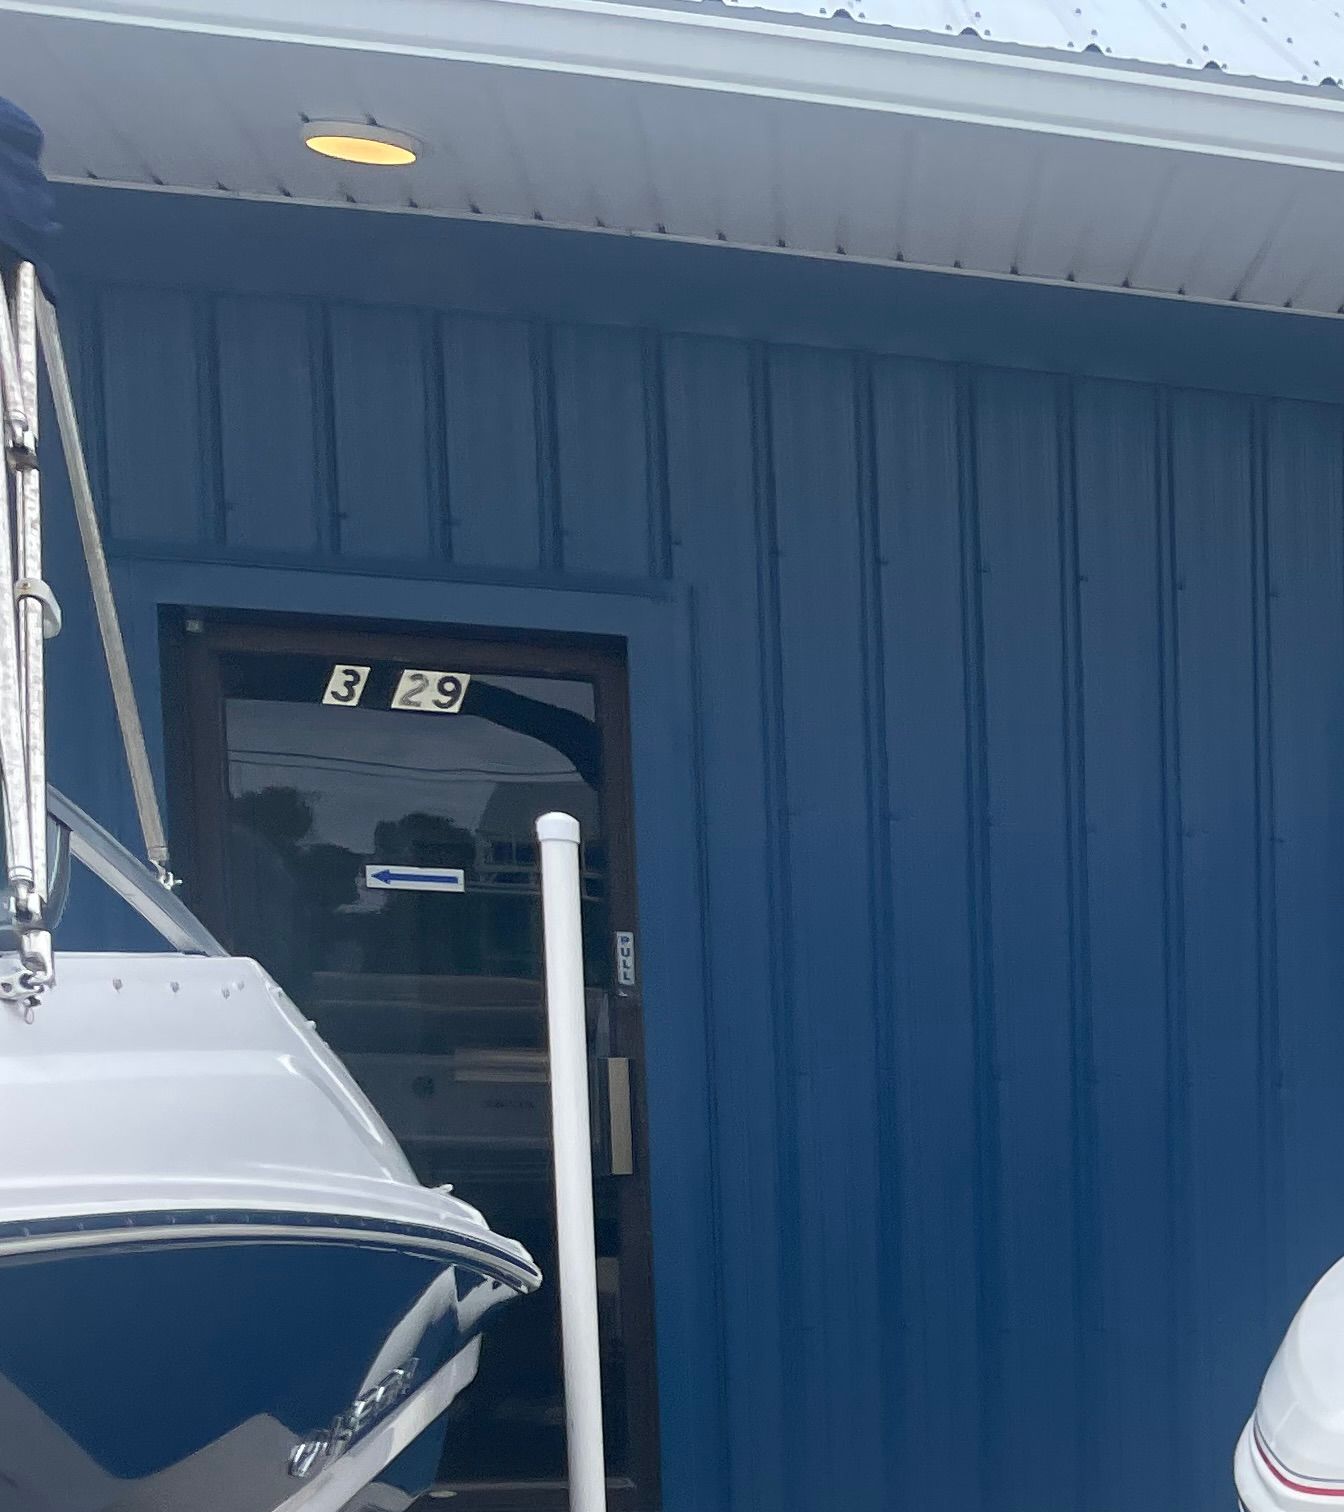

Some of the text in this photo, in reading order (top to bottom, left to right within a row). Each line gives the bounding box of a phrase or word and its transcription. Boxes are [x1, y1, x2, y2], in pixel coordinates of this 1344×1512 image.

[331, 669, 462, 709] 3 29
[620, 935, 631, 981] PULL
